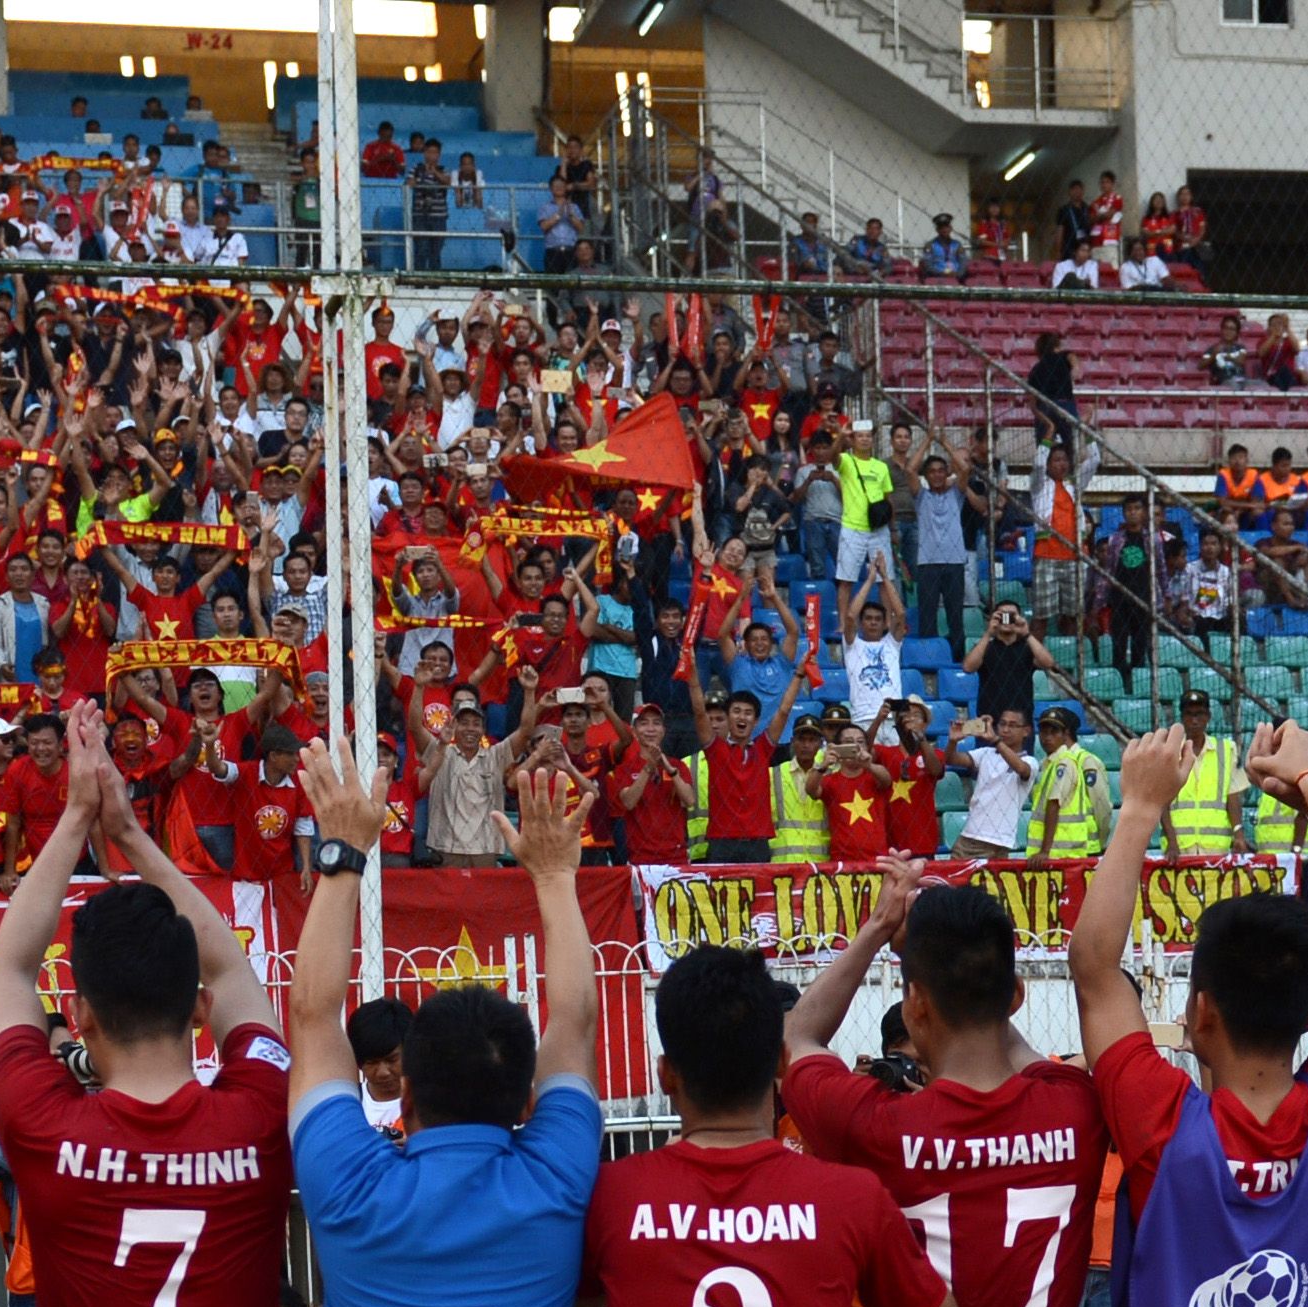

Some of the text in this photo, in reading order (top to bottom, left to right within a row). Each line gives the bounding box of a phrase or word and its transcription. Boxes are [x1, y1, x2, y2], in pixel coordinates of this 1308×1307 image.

[188, 33, 233, 50] W-24
[180, 526, 227, 545] NAM
[655, 877, 755, 959] ONE
[773, 871, 886, 952] LOV
[57, 1140, 260, 1186] N.H.THINH
[902, 1127, 1076, 1171] V.V.THANH
[630, 1203, 817, 1244] A.V.HOAN
